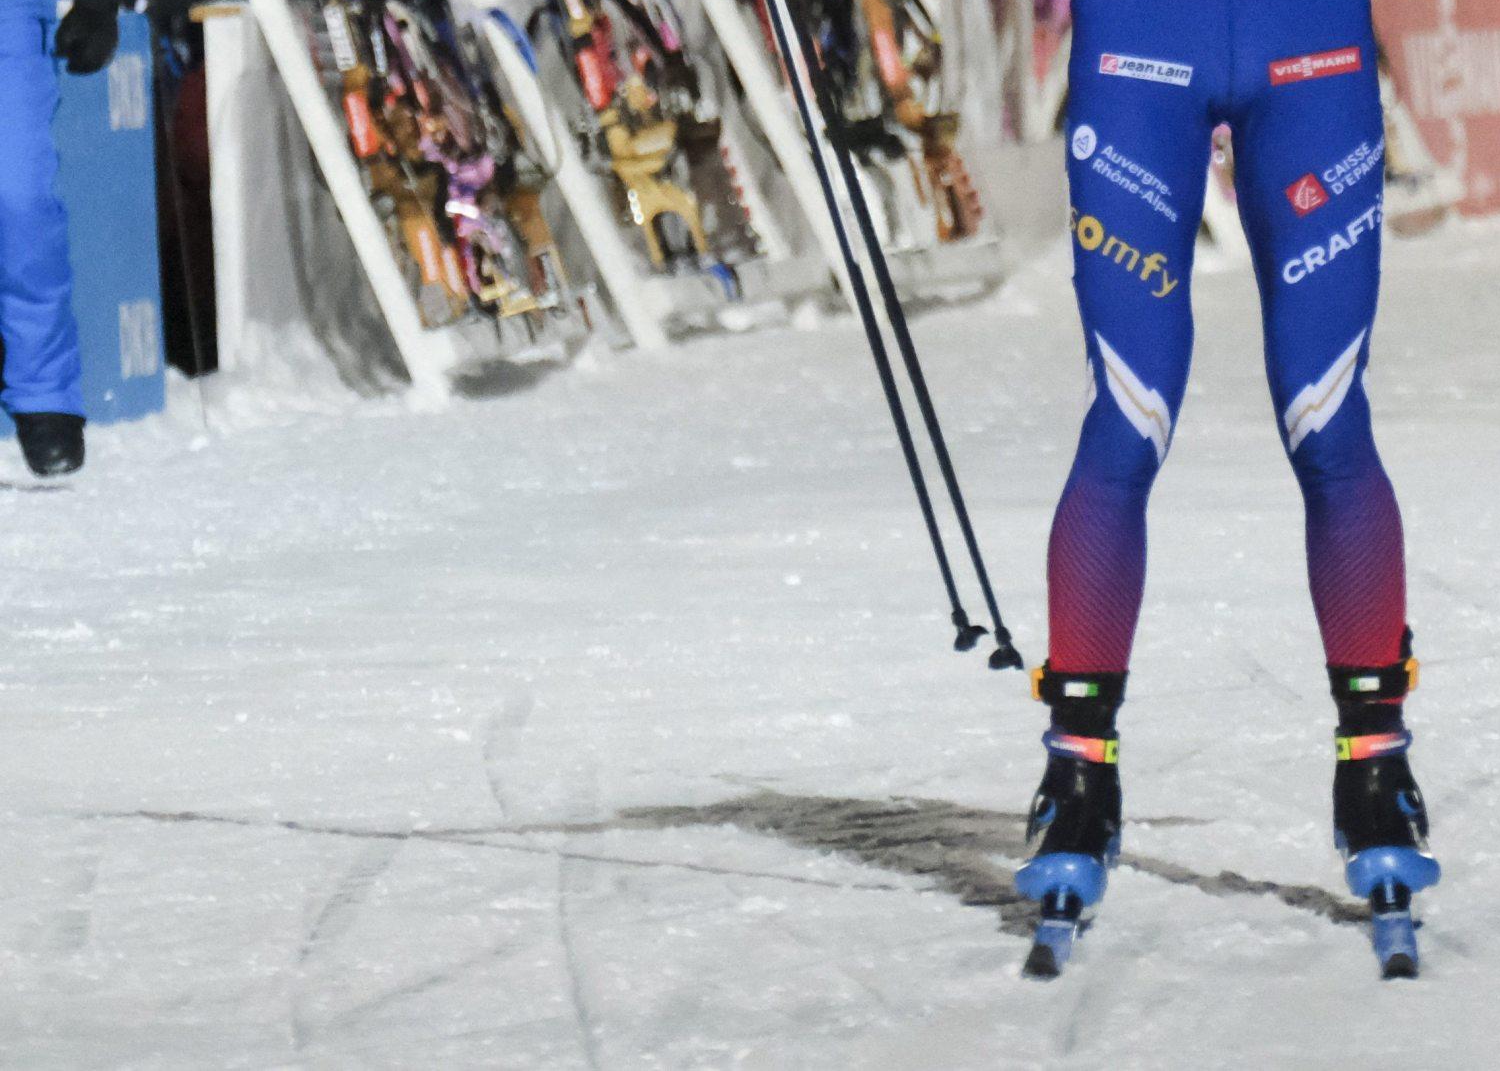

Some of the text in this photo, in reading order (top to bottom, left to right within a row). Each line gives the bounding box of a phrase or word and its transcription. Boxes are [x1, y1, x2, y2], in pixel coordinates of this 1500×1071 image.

[1092, 158, 1179, 223] Rhône-Alpes
[1101, 145, 1172, 197] Auvergne-
[1323, 141, 1371, 183] CAISSE
[1282, 206, 1376, 285] CRAFT
